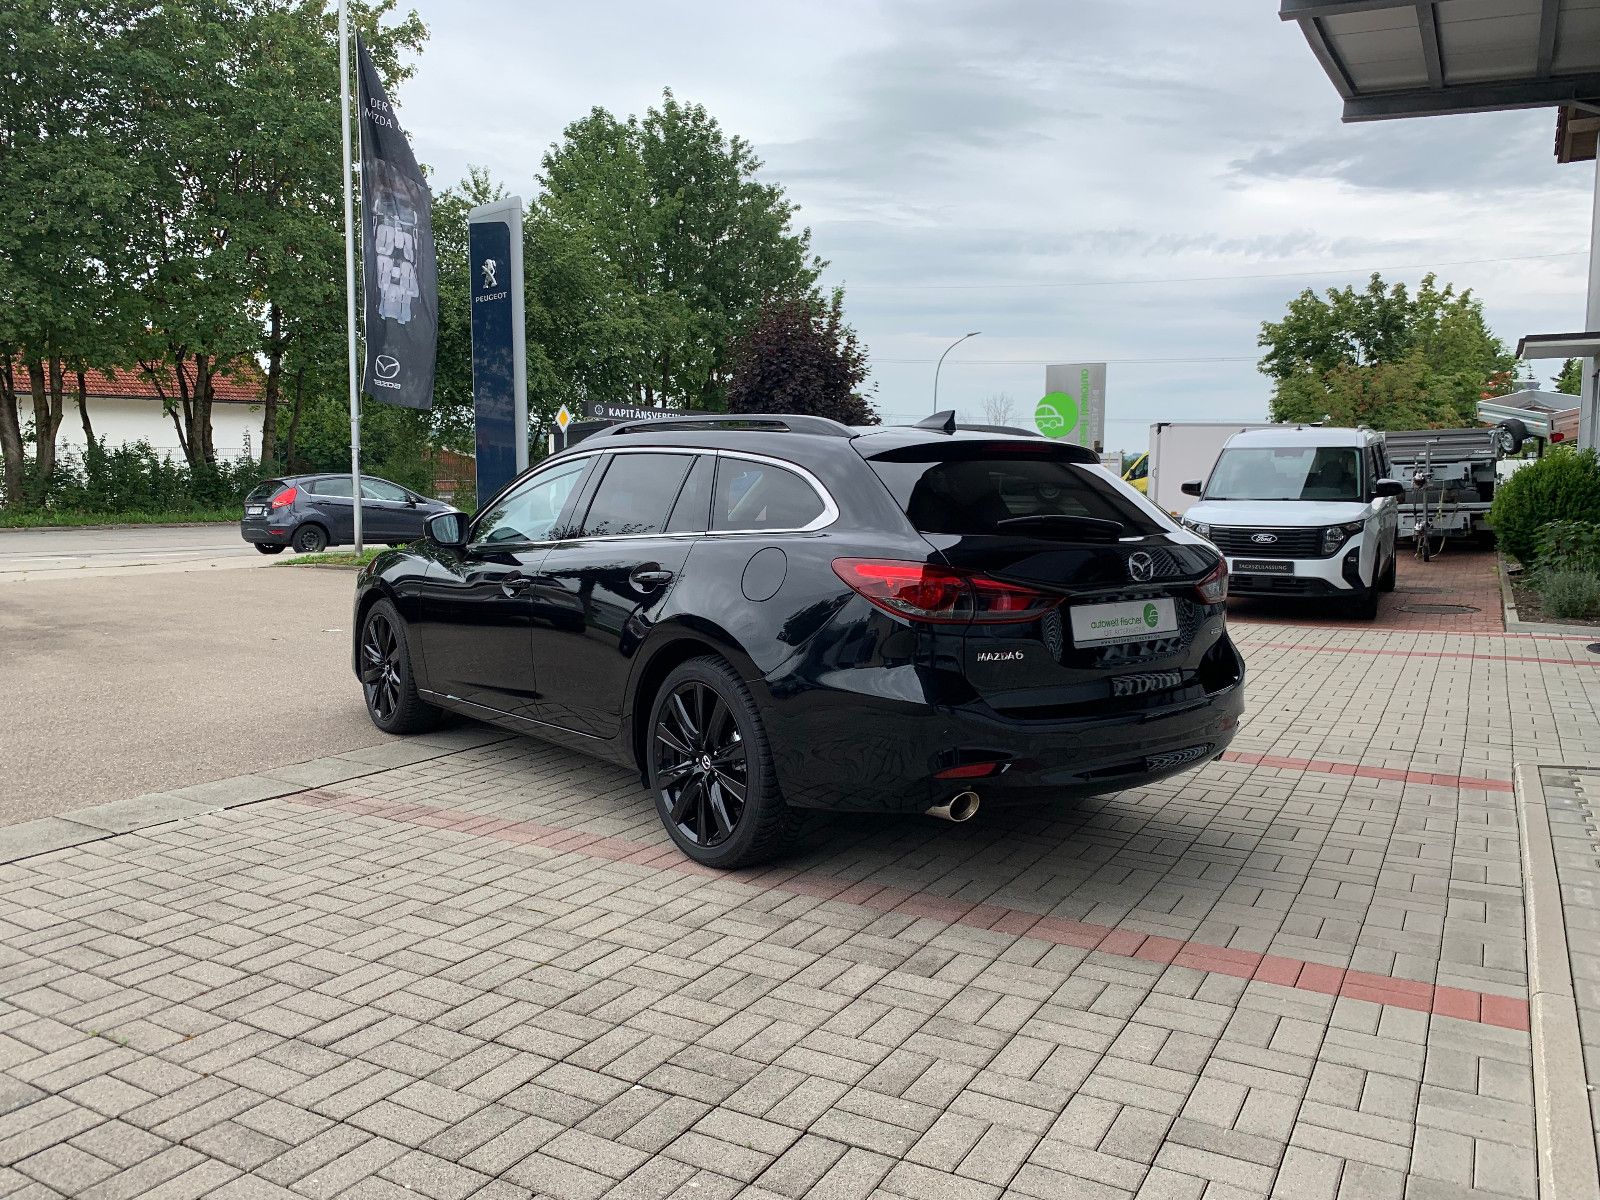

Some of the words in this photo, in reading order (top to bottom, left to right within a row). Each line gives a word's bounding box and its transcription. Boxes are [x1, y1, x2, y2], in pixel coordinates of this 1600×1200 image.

[370, 97, 389, 112] DER
[475, 291, 508, 303] PEUGEOT
[1255, 533, 1273, 542] Ford
